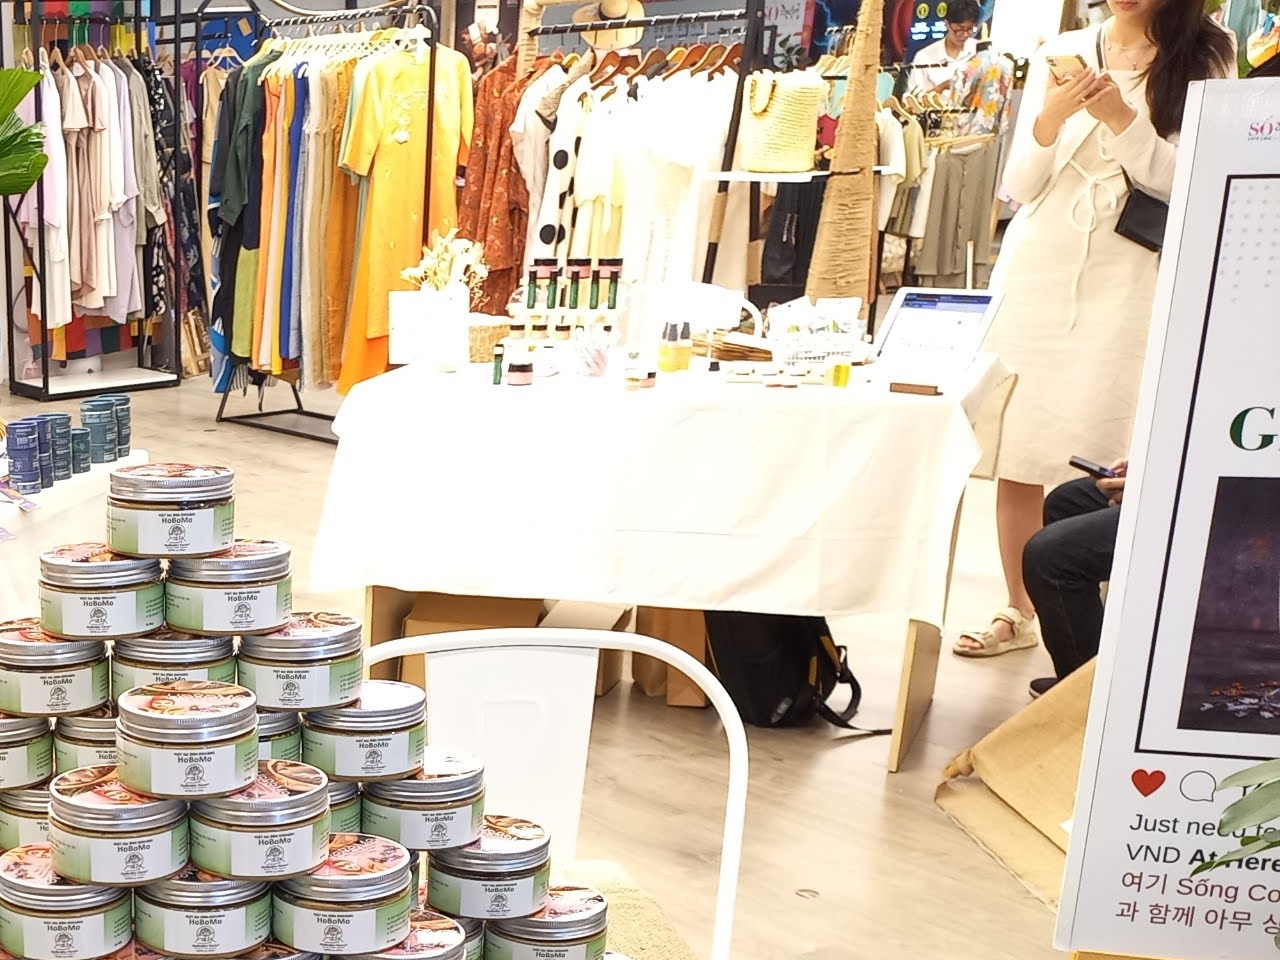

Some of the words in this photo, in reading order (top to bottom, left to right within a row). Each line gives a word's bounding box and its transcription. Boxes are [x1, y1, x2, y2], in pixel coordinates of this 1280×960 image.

[358, 742, 390, 750] HoBoMo
[178, 756, 212, 764] HoBoMo
[424, 815, 454, 824] HoBoMo
[1130, 814, 1179, 834] Just
[258, 838, 292, 846] HoBoMo
[118, 844, 150, 853] HoBoMo
[1126, 844, 1181, 864] VND
[484, 886, 514, 894] HoBoMo
[1122, 872, 1168, 894] 여기
[1176, 878, 1239, 904] Sống
[1115, 901, 1140, 922] 과
[1149, 903, 1196, 928] 함께
[1204, 909, 1253, 932] 아무
[189, 918, 222, 926] HoBoMo
[316, 917, 350, 926] HoBoMo
[47, 924, 80, 932] HoBoMo
[536, 951, 566, 959] HoBoMo
